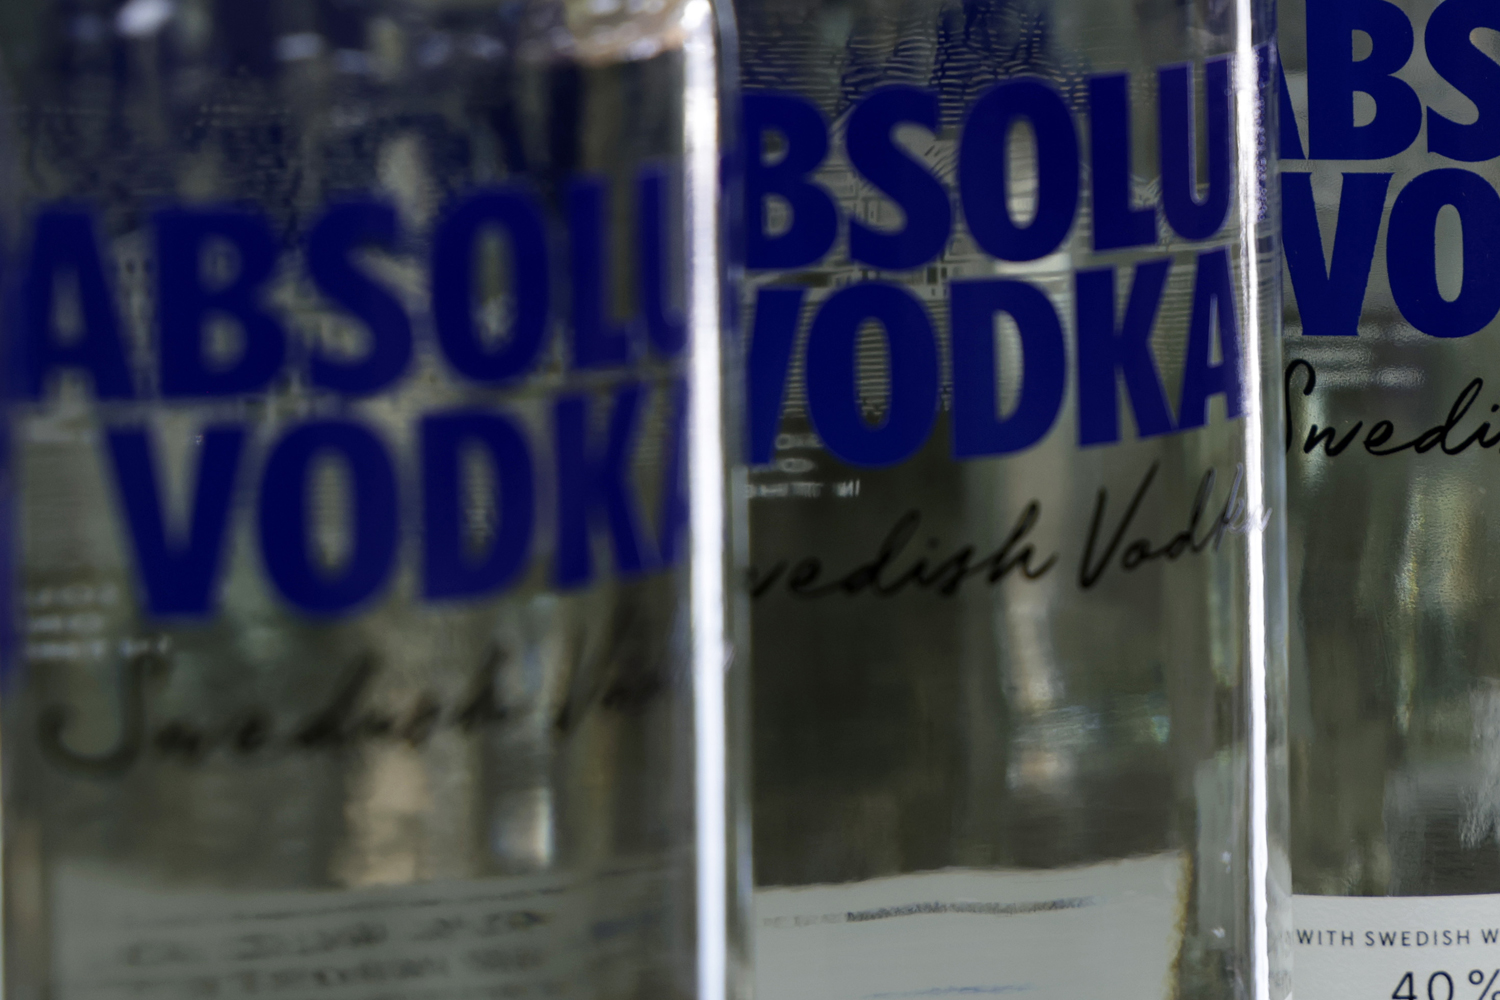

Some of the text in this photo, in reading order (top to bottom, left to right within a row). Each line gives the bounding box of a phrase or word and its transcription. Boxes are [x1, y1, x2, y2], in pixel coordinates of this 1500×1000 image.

[102, 378, 692, 625] VODK
[1297, 929, 1354, 946] WITH
[1365, 929, 1470, 947] SWEDISH
